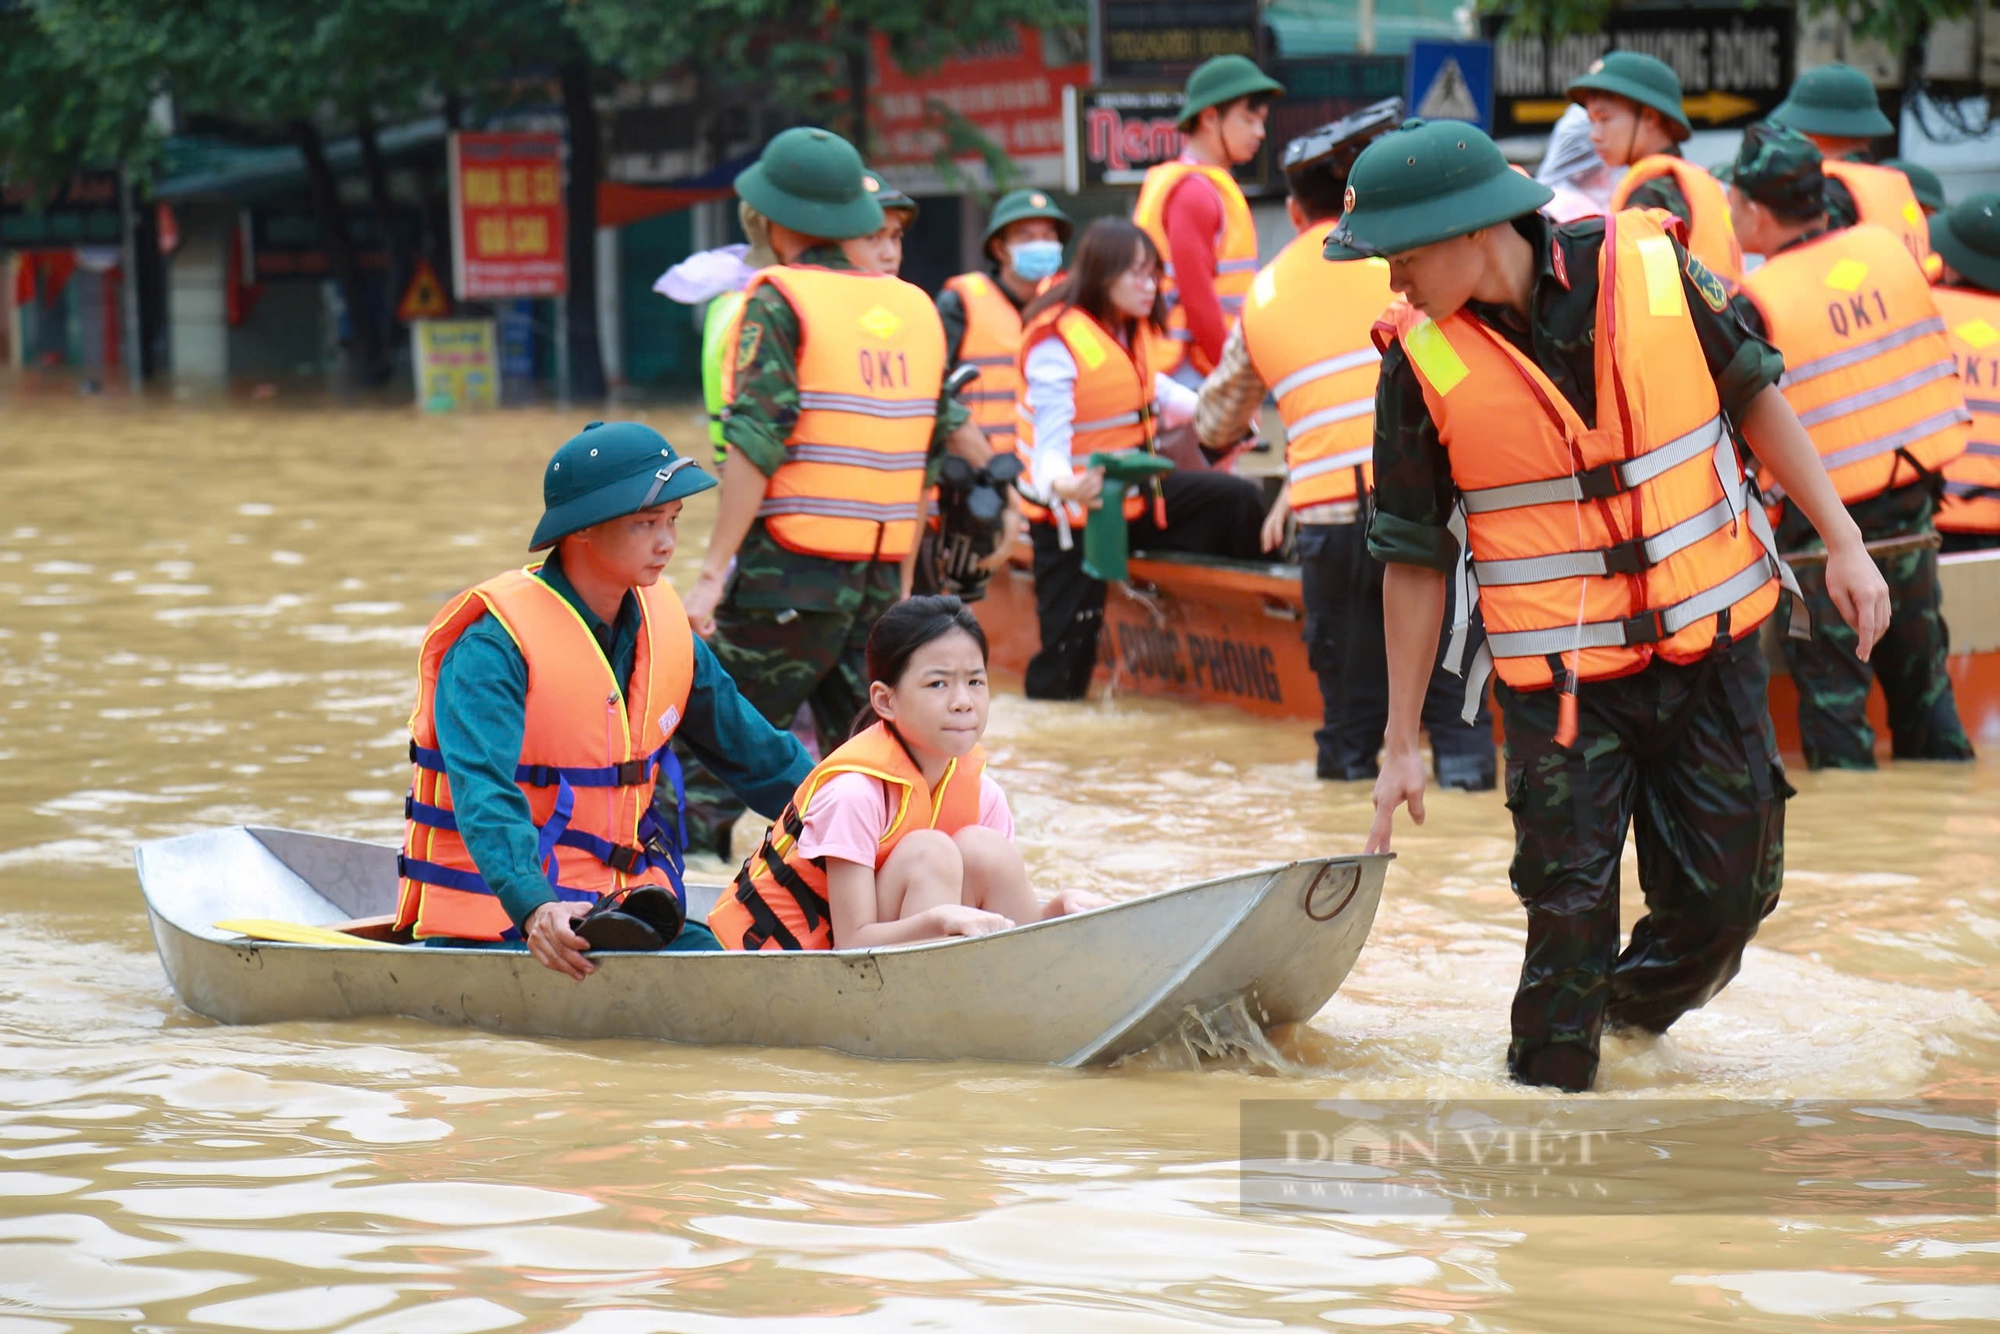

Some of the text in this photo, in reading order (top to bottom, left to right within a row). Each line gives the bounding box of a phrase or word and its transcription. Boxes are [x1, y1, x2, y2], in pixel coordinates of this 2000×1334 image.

[1828, 290, 1888, 337] QK1
[858, 349, 908, 391] QK1
[1187, 625, 1284, 704] PHÒNG
